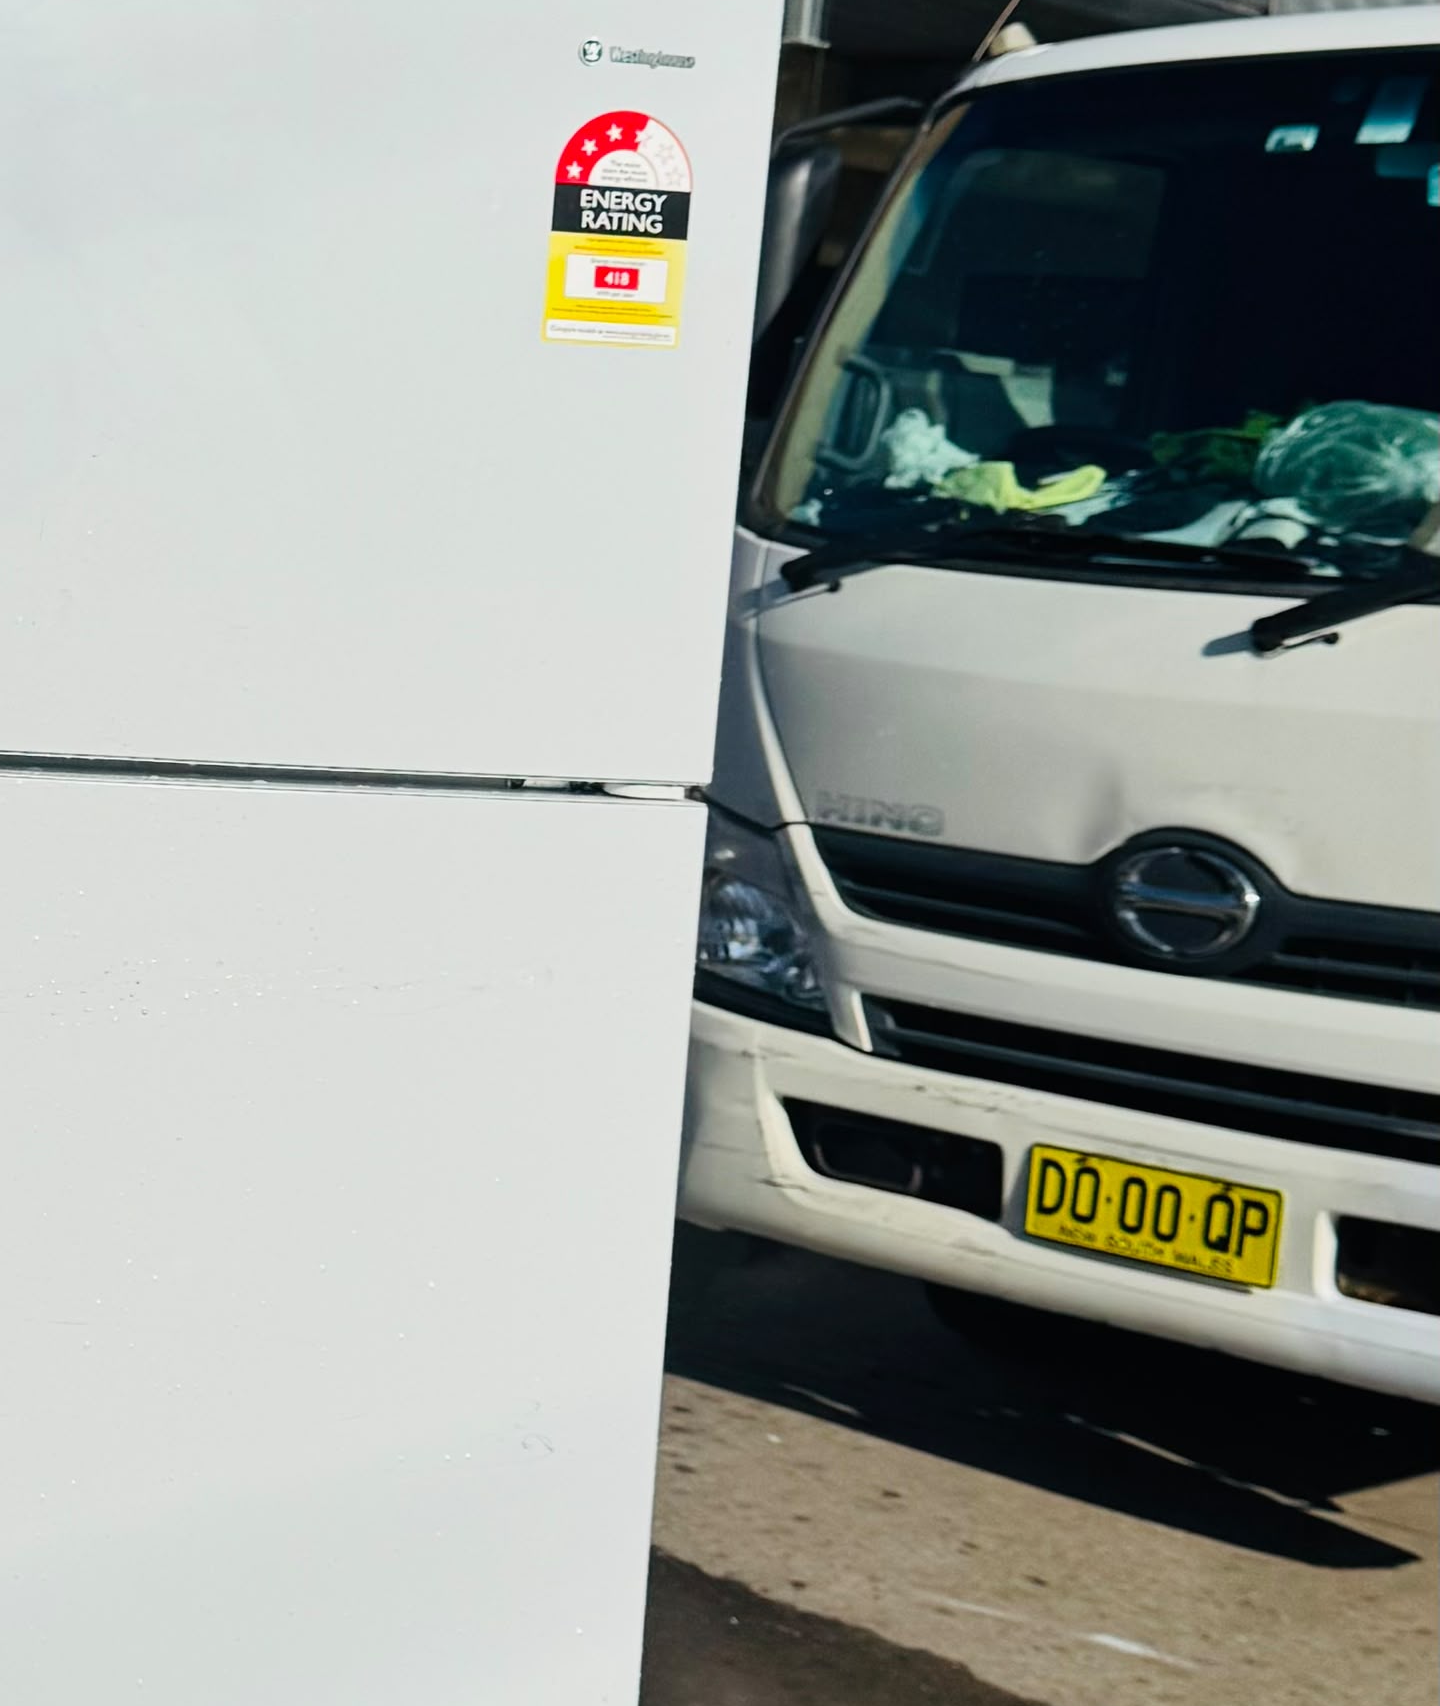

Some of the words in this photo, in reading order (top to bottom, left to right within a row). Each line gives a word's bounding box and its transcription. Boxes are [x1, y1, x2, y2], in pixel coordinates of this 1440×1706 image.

[580, 189, 668, 213] ENERGY
[581, 210, 663, 234] RATING
[812, 791, 945, 837] HINO
